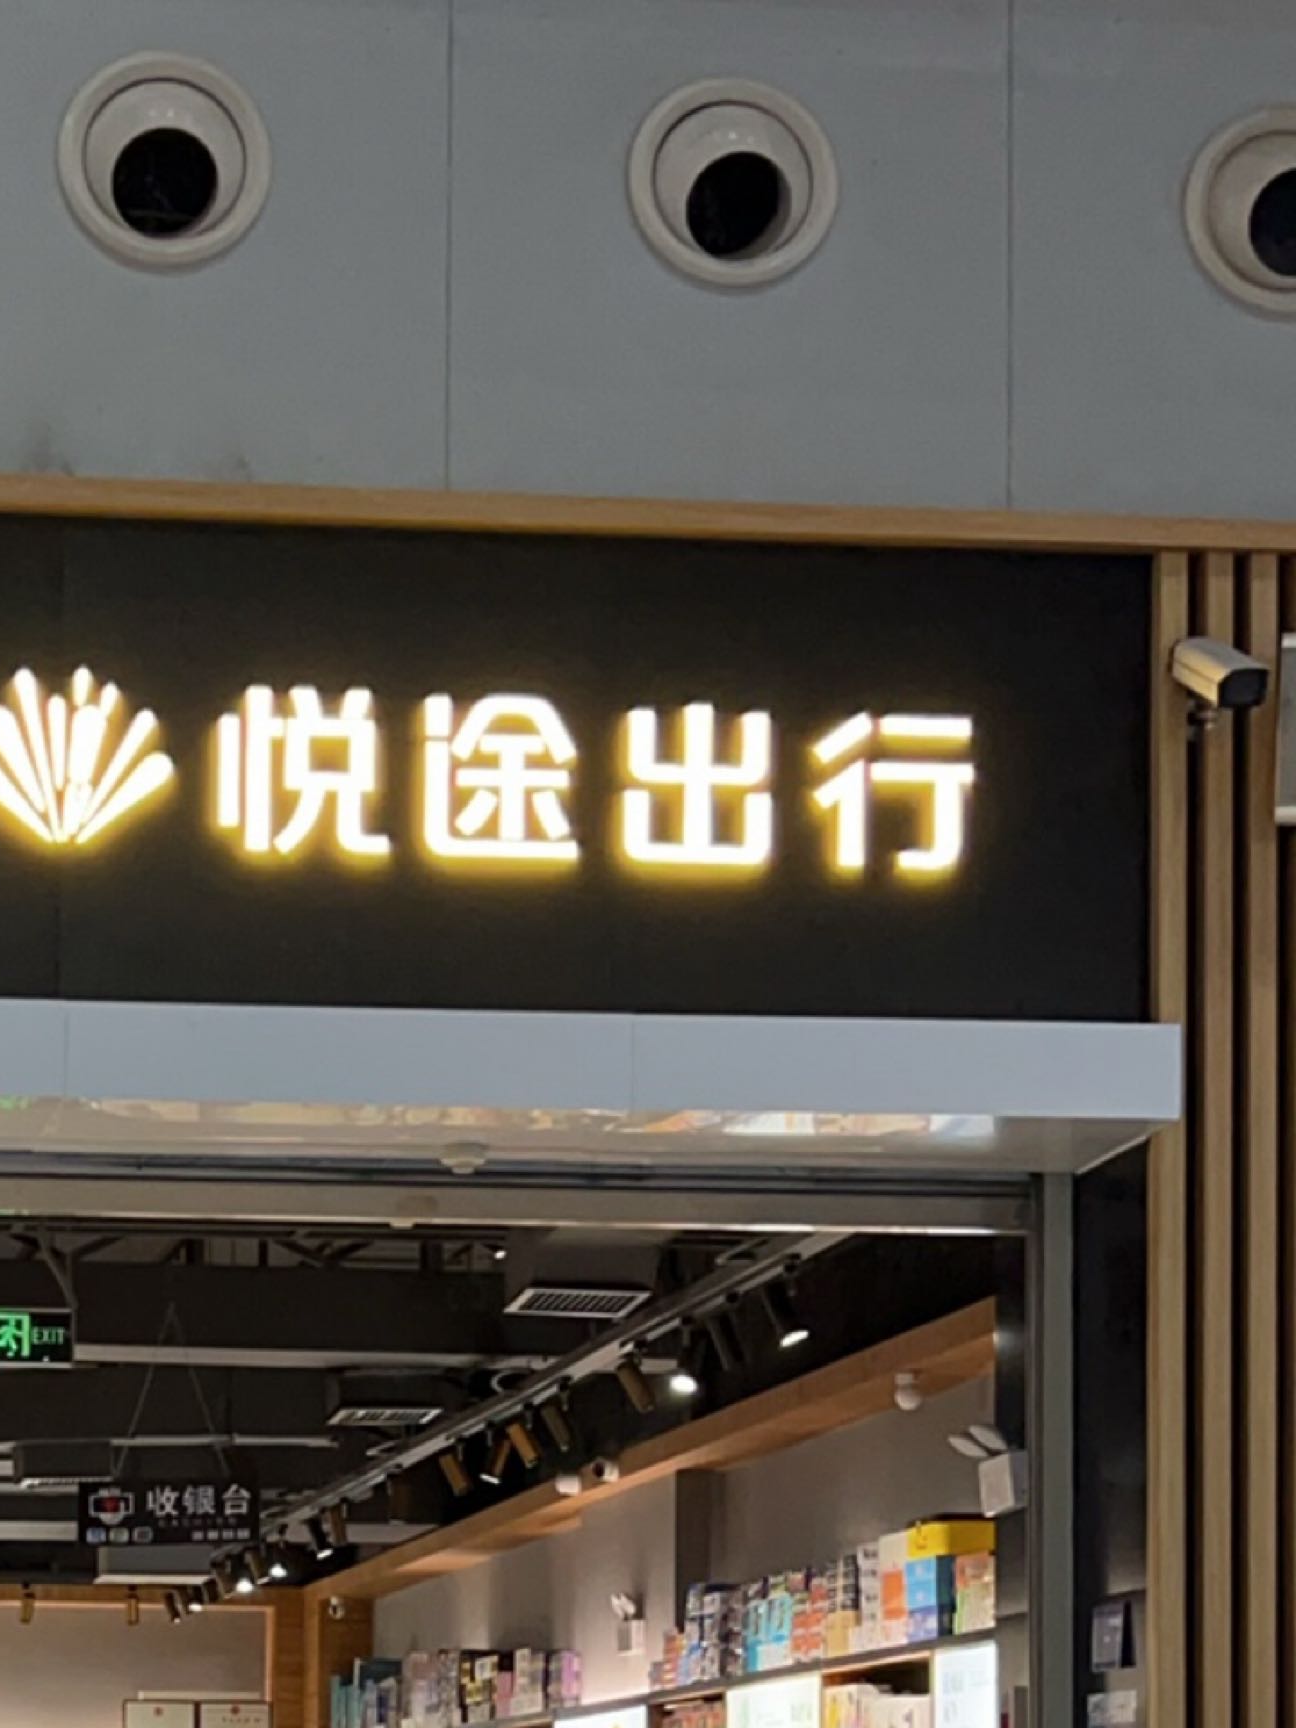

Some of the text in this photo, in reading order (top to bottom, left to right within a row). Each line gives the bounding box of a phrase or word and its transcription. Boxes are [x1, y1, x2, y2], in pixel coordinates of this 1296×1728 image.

[217, 684, 974, 871] 悦途出行
[32, 1326, 65, 1345] EXIT
[146, 1483, 251, 1517] 收银台
